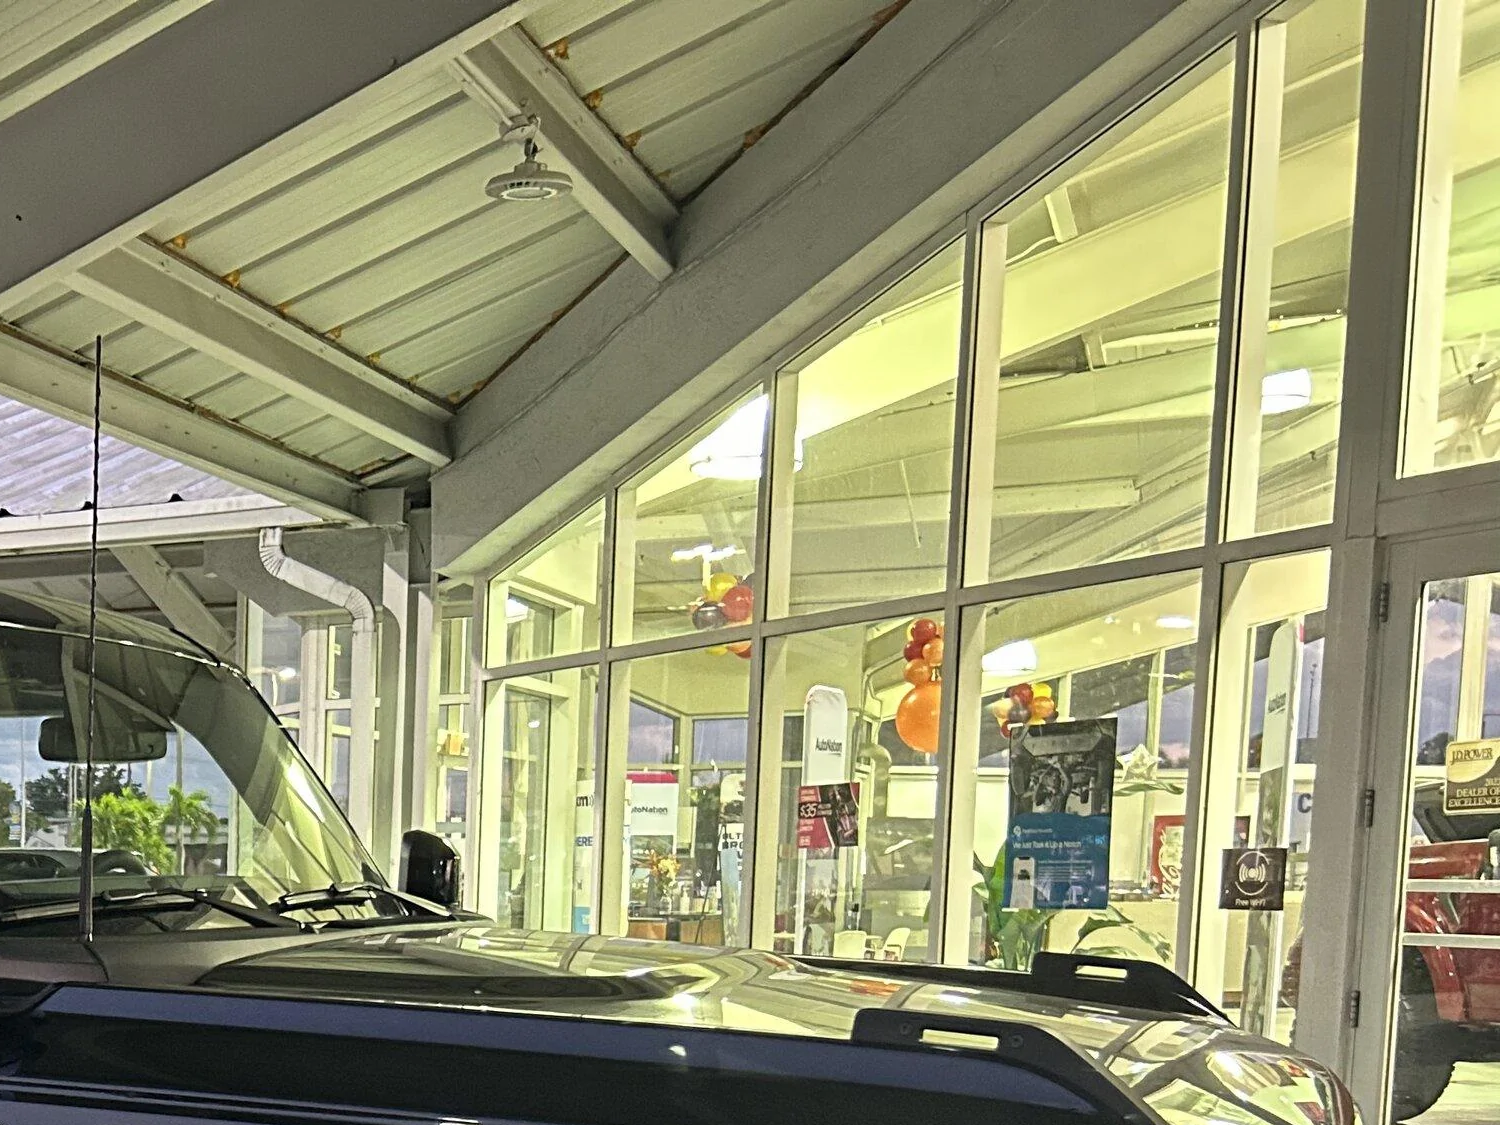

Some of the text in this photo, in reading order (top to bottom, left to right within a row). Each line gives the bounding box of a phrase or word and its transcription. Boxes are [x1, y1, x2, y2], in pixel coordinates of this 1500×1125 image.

[1464, 748, 1493, 760] POWER
[1456, 787, 1487, 797] DEALER
[800, 803, 816, 817] $35
[1235, 898, 1249, 906] Free
